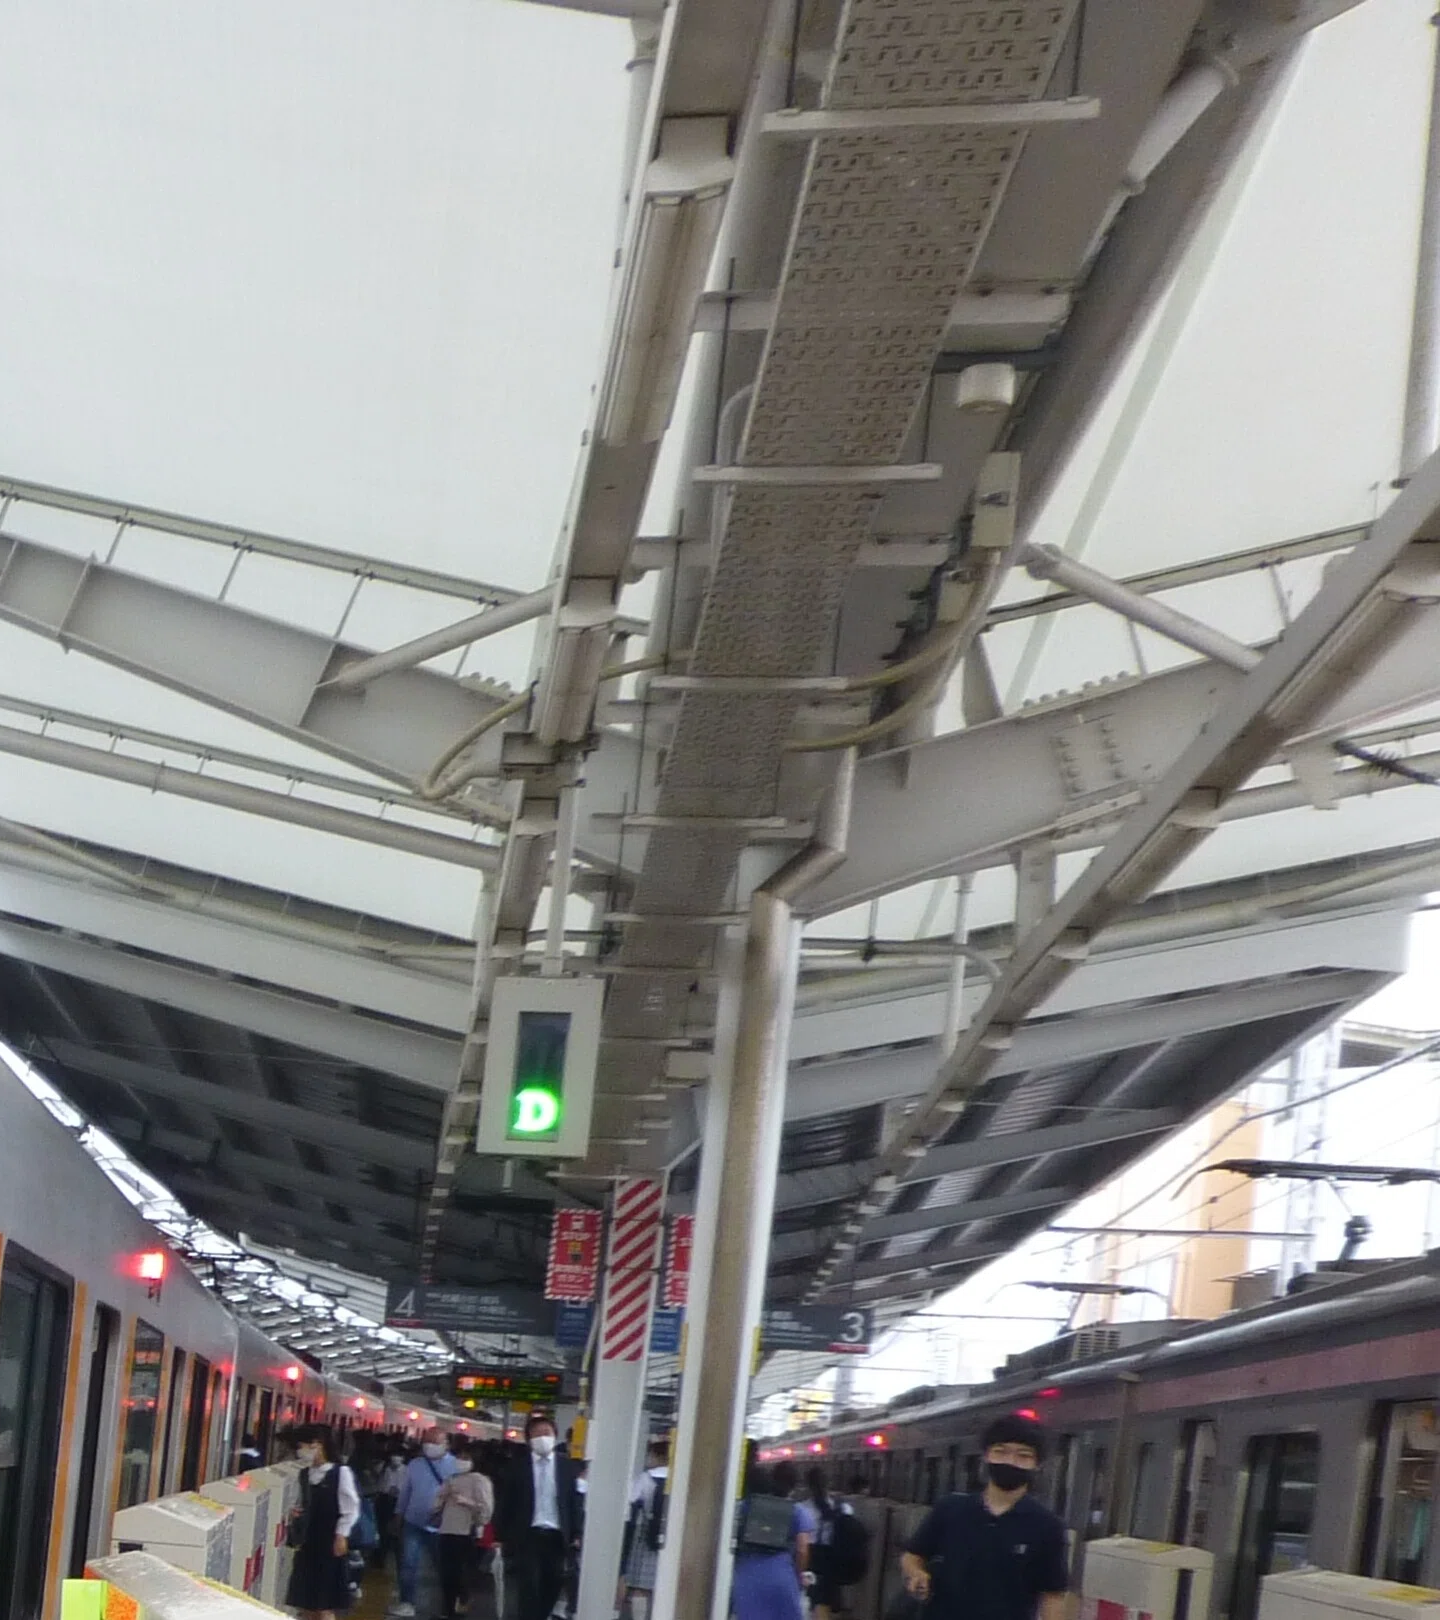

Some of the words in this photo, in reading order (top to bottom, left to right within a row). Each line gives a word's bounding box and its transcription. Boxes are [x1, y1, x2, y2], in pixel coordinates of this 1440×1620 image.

[513, 1088, 560, 1132] D
[394, 1288, 416, 1318] 4
[840, 1311, 865, 1343] 3
